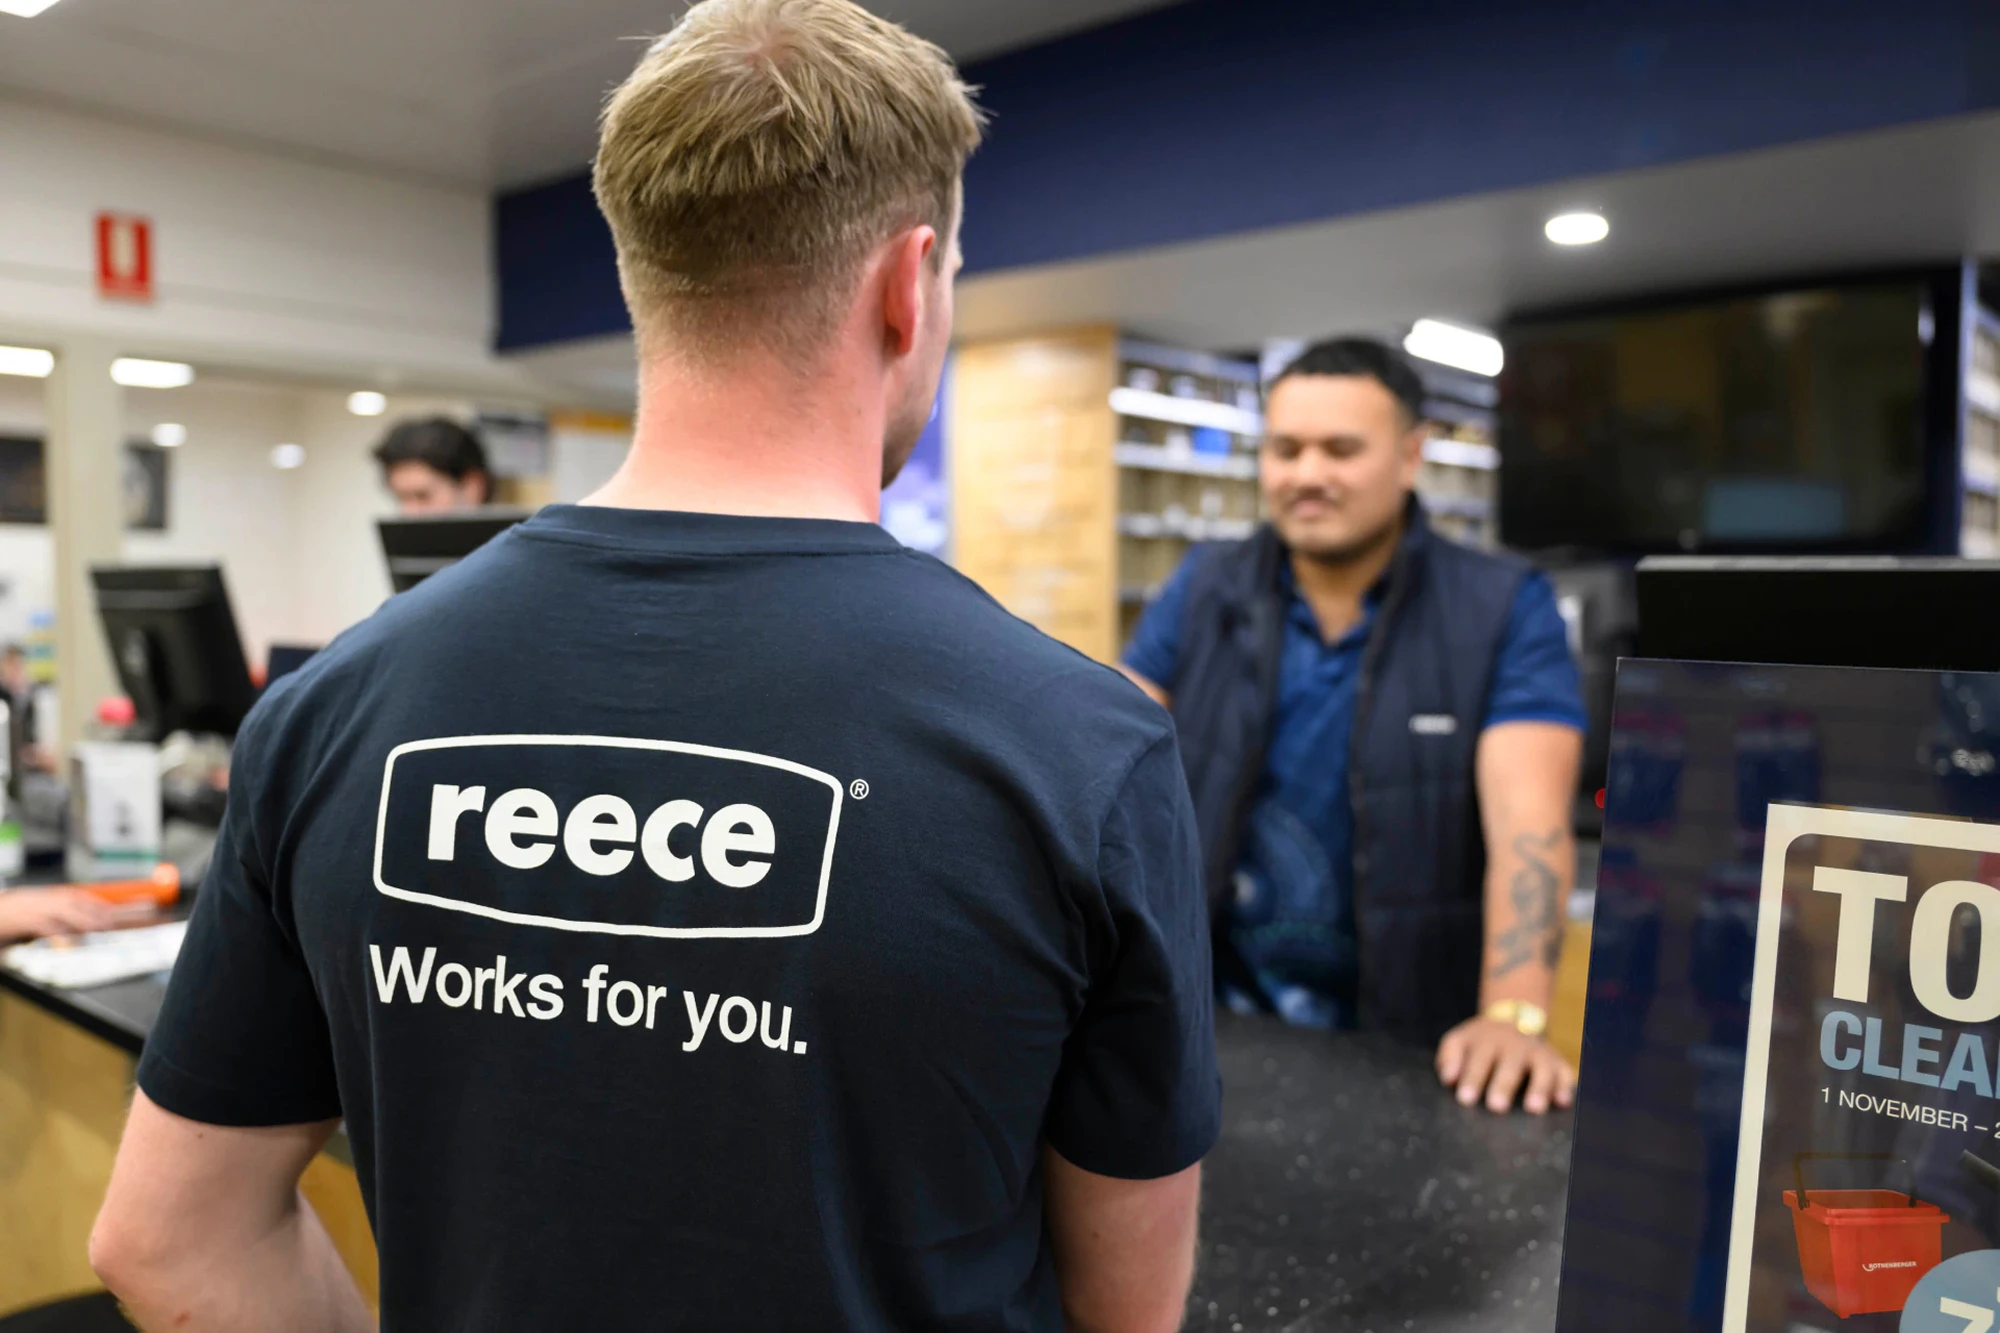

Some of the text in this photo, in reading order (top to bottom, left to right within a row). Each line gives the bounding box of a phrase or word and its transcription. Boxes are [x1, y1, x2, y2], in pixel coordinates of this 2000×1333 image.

[427, 783, 776, 888] reece
[369, 944, 808, 1055] Works for you.
[1819, 1010, 2000, 1100] CLEA
[1821, 1086, 1830, 1104] 1
[1838, 1089, 1968, 1132] NOVEMBER
[1867, 1260, 1917, 1270] ROTHENBERGER
